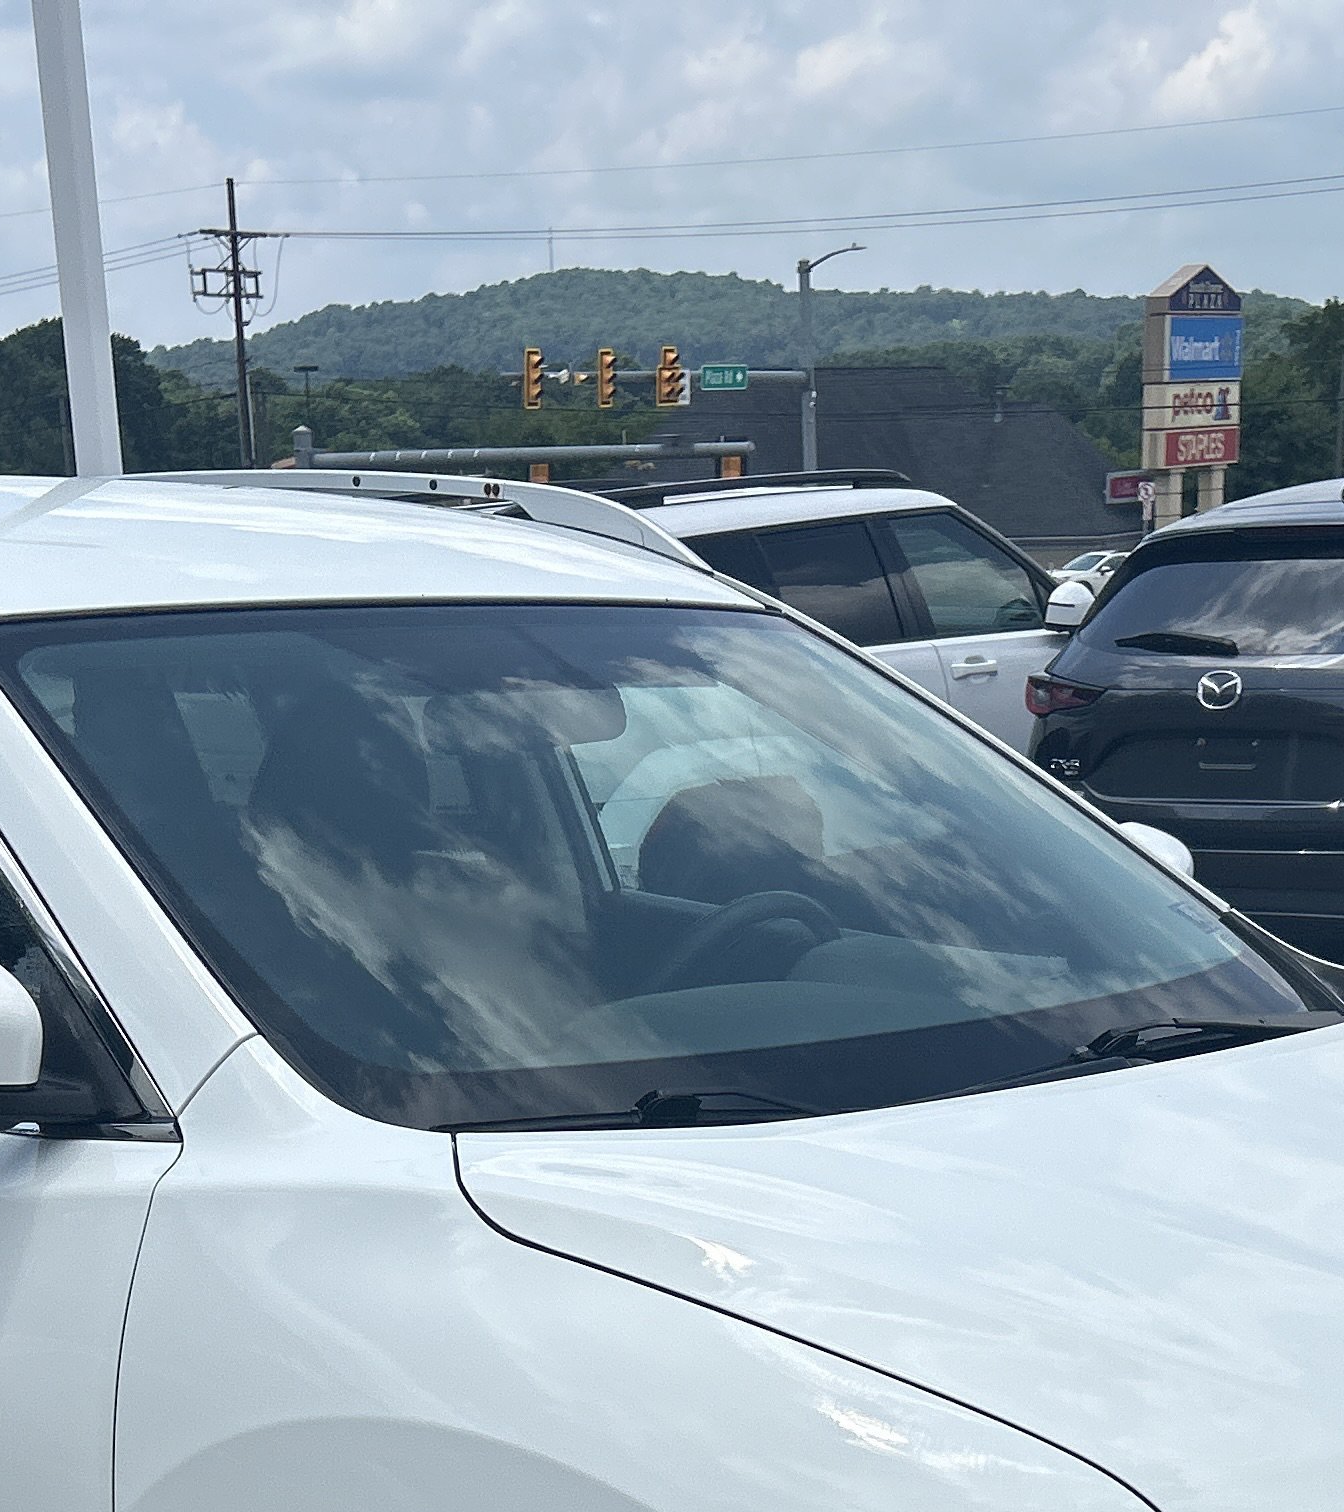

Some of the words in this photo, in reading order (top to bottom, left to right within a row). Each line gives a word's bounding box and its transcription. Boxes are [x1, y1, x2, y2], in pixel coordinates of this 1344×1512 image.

[1171, 335, 1219, 361] Walmart
[1171, 388, 1214, 423] petco
[1177, 432, 1225, 461] STAPLES
